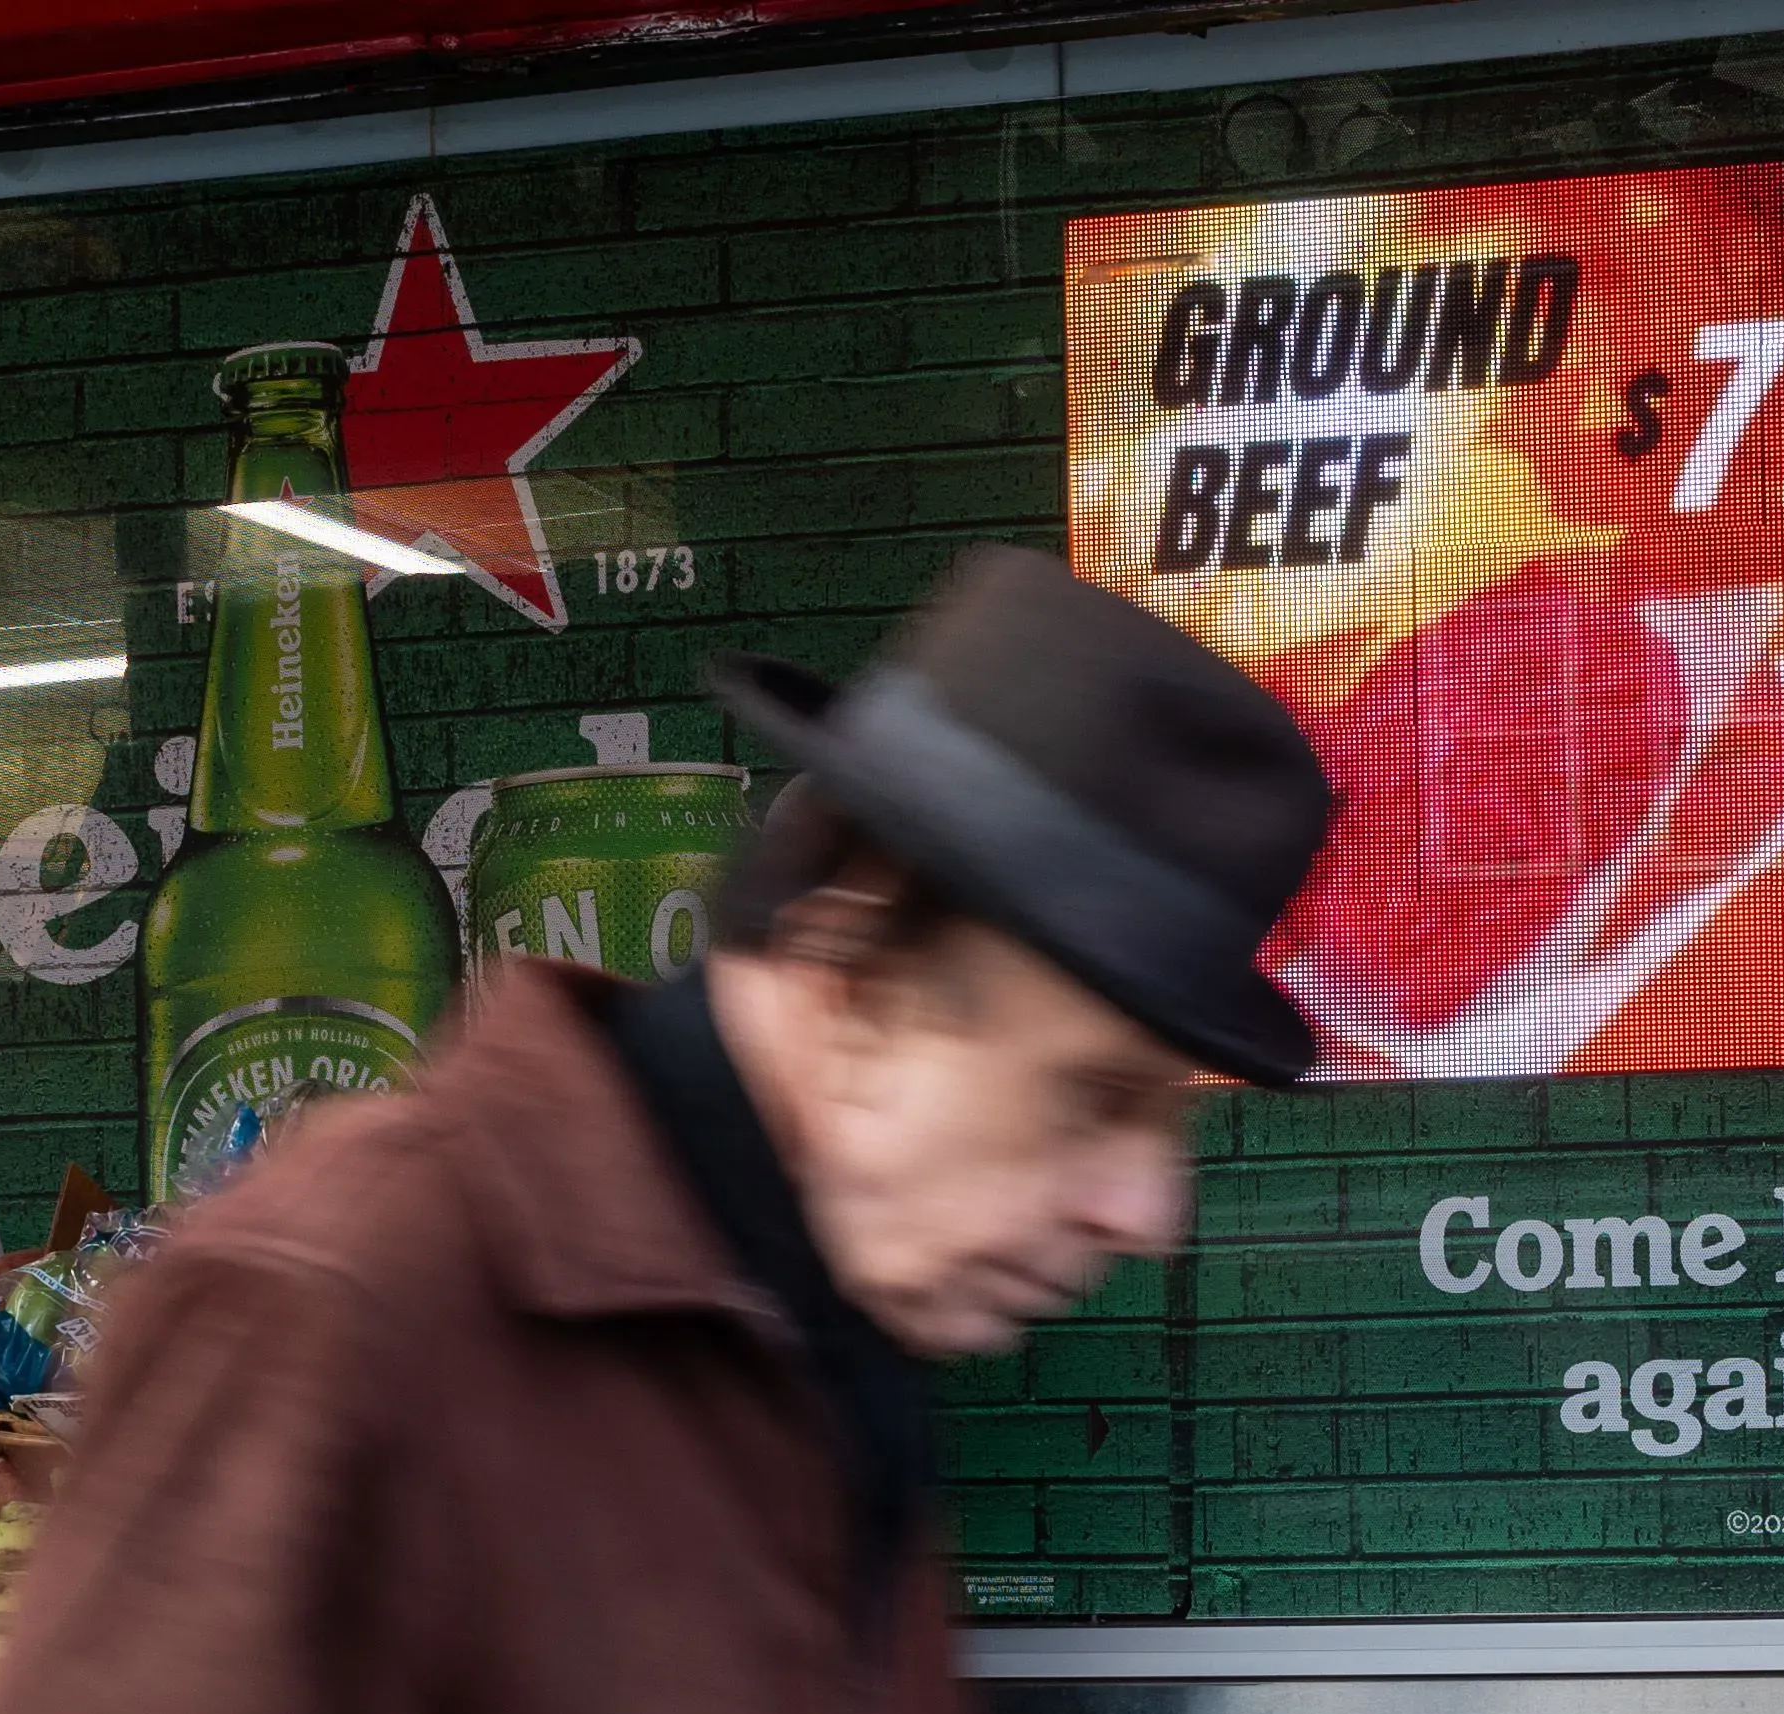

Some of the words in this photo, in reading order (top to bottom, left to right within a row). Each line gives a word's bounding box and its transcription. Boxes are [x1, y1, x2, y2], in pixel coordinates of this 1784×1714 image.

[1154, 254, 1579, 412] GROUND
[1154, 433, 1414, 575] BEEF
[594, 545, 696, 595] 1873
[272, 548, 304, 750] Heineken
[227, 1032, 280, 1056] BREWED
[287, 1030, 303, 1041] IN
[311, 1028, 370, 1049] HOLLAND
[1419, 1195, 1748, 1296] Come
